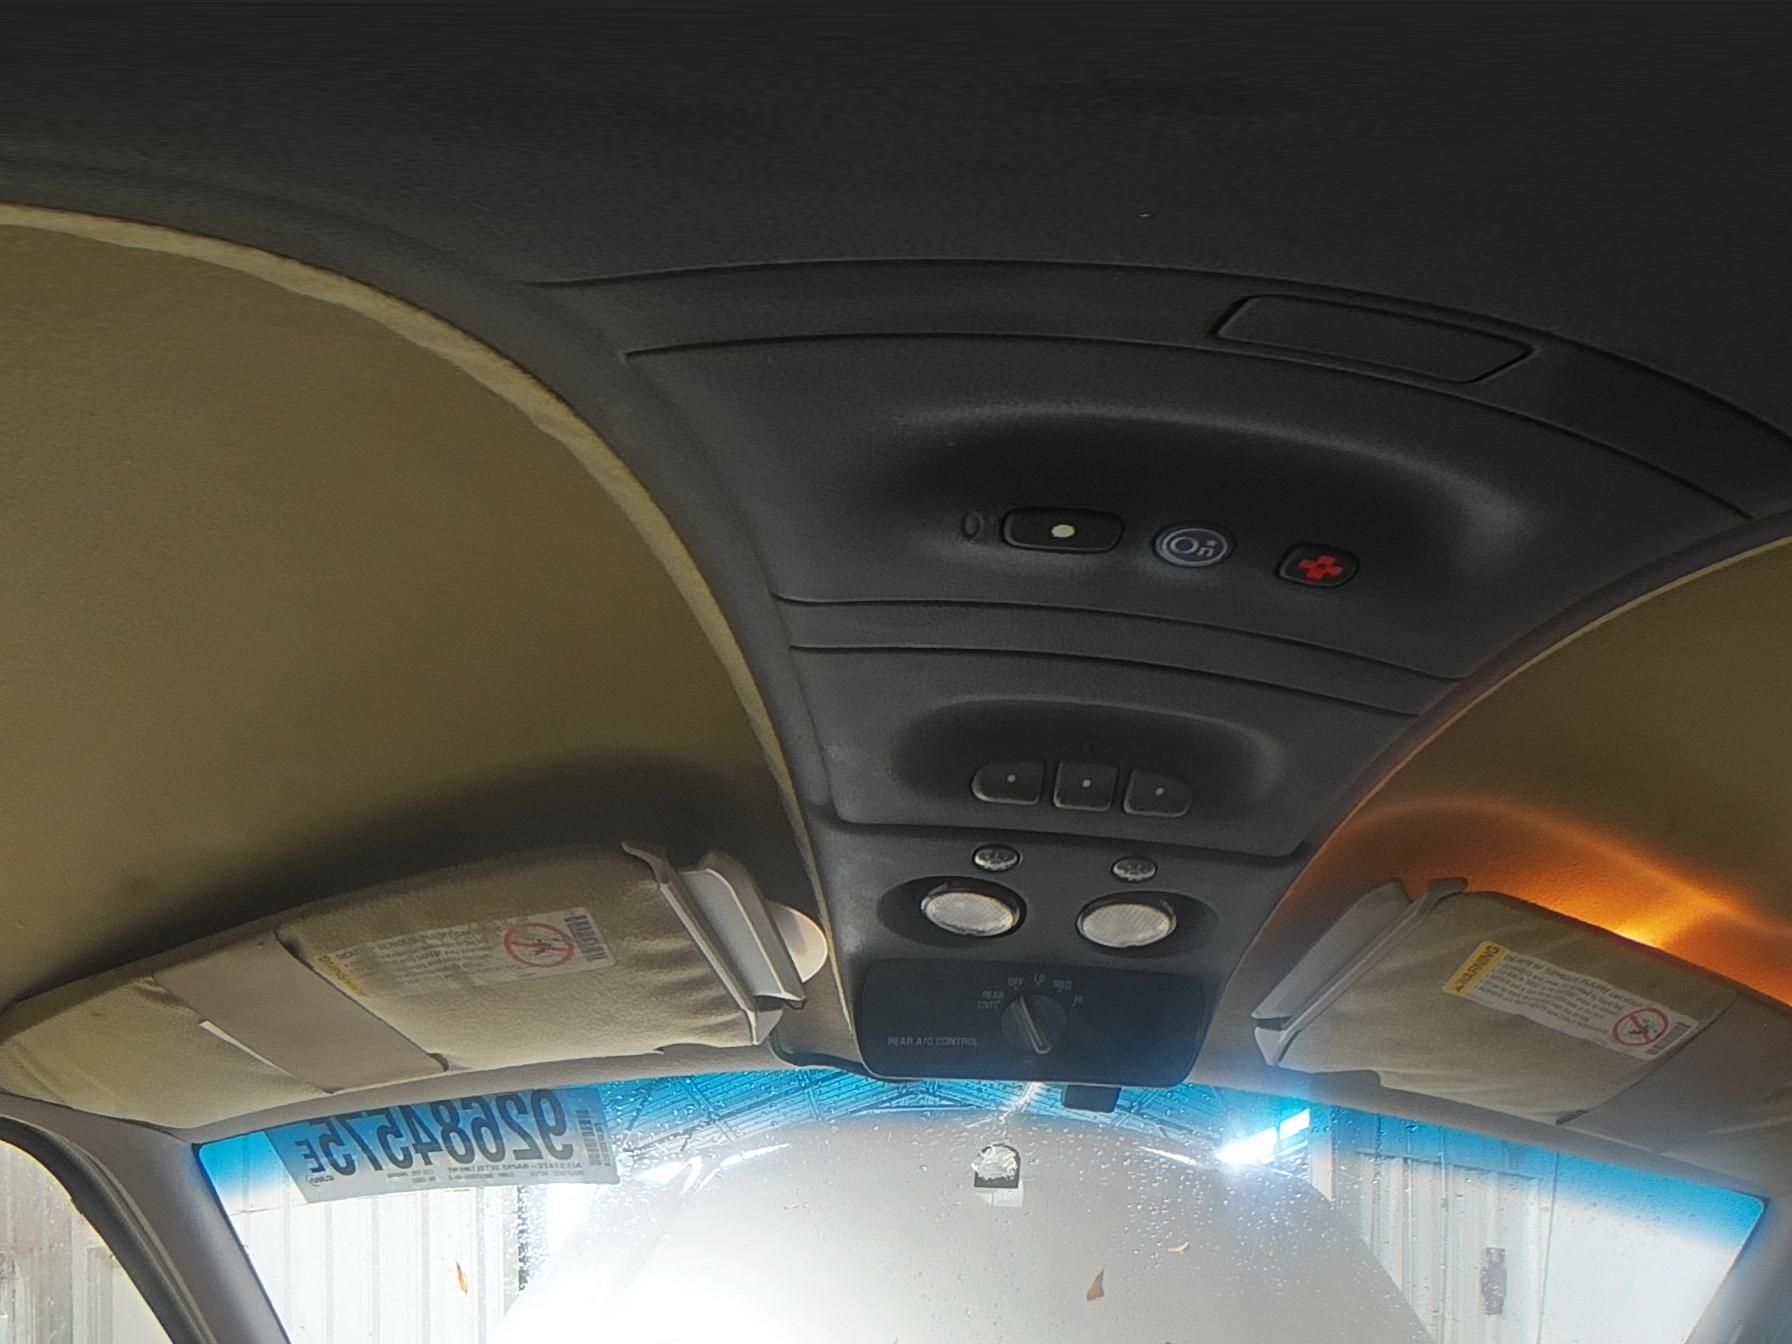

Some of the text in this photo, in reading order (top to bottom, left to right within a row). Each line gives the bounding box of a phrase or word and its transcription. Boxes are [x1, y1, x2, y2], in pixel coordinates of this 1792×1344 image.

[1454, 945, 1500, 985] WARNING
[982, 990, 1004, 1000] REAR
[888, 1036, 979, 1046] REAR A/C CONTROL
